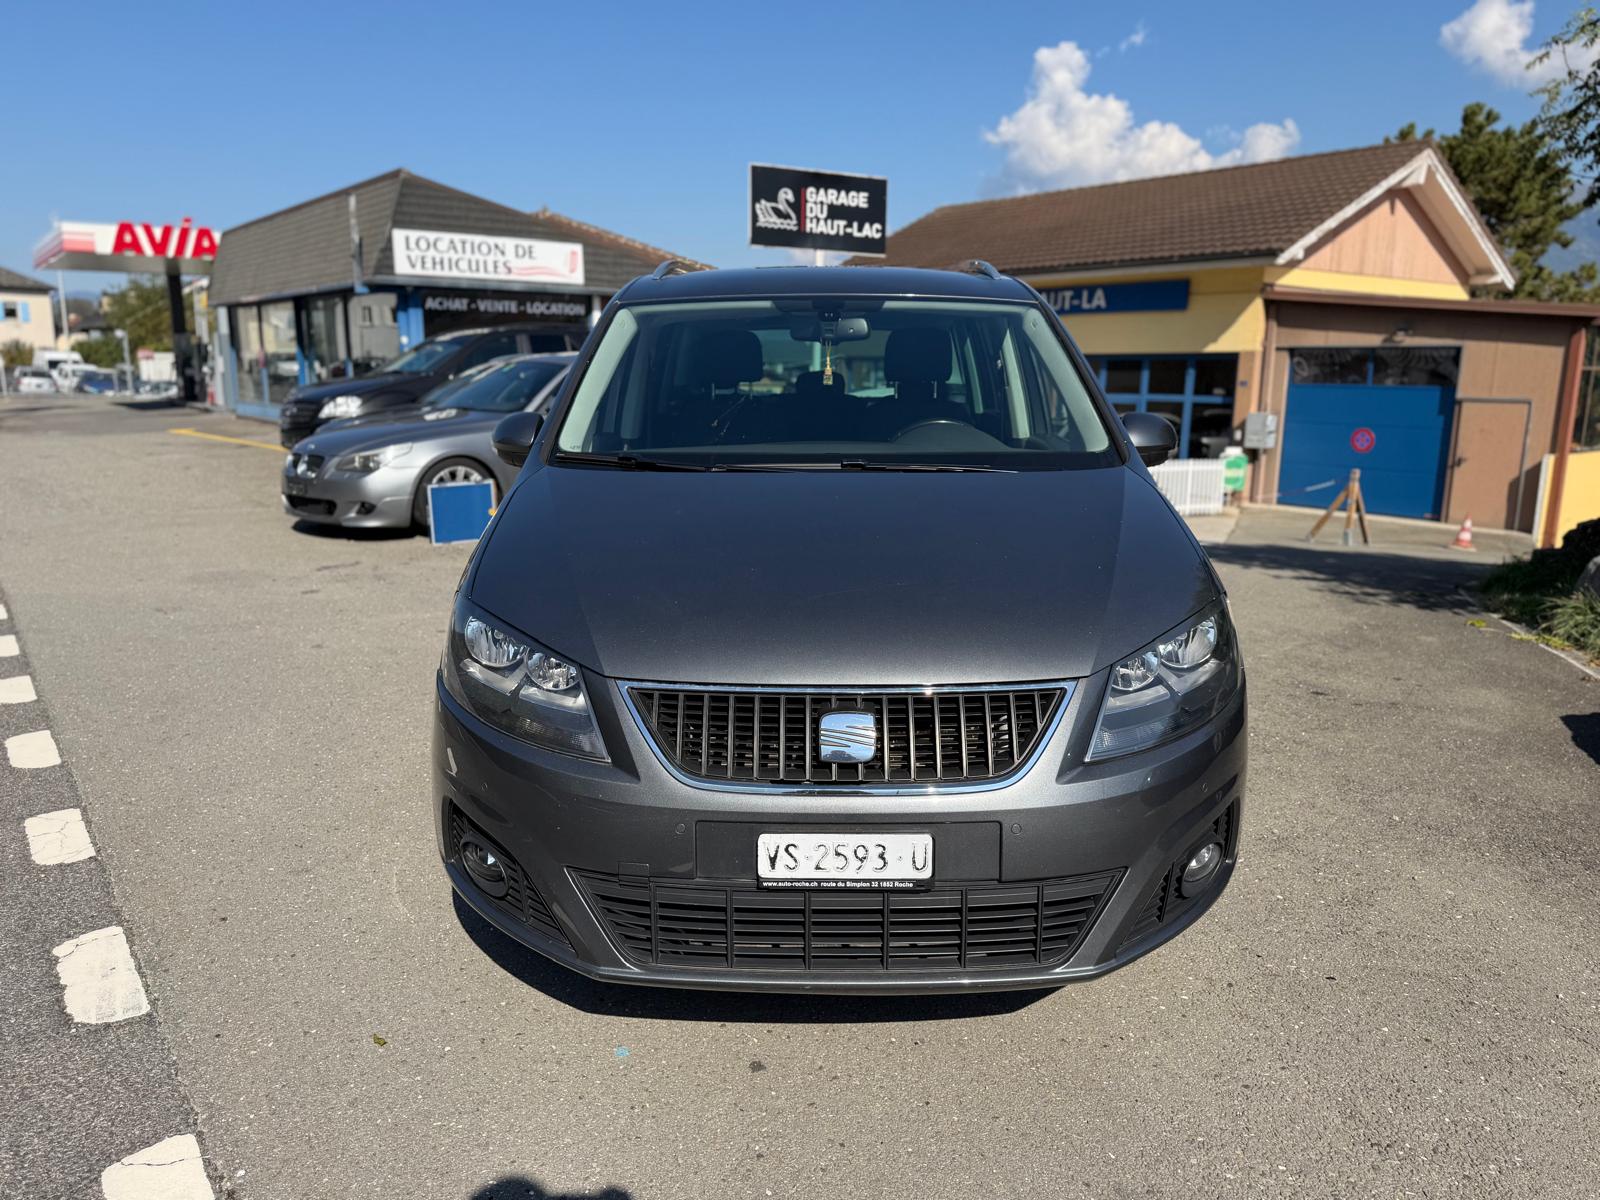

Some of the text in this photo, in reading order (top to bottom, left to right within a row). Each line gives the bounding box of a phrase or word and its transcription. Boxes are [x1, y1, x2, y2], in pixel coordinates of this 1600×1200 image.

[805, 186, 869, 208] GARAGE
[805, 202, 828, 219] DU
[805, 218, 882, 239] HAUT-LAC
[405, 235, 536, 260] LOCATION DE
[406, 255, 513, 275] VEHICULES
[425, 296, 585, 316] ACHAT VENTE LOCATION
[846, 881, 871, 889] Simplon
